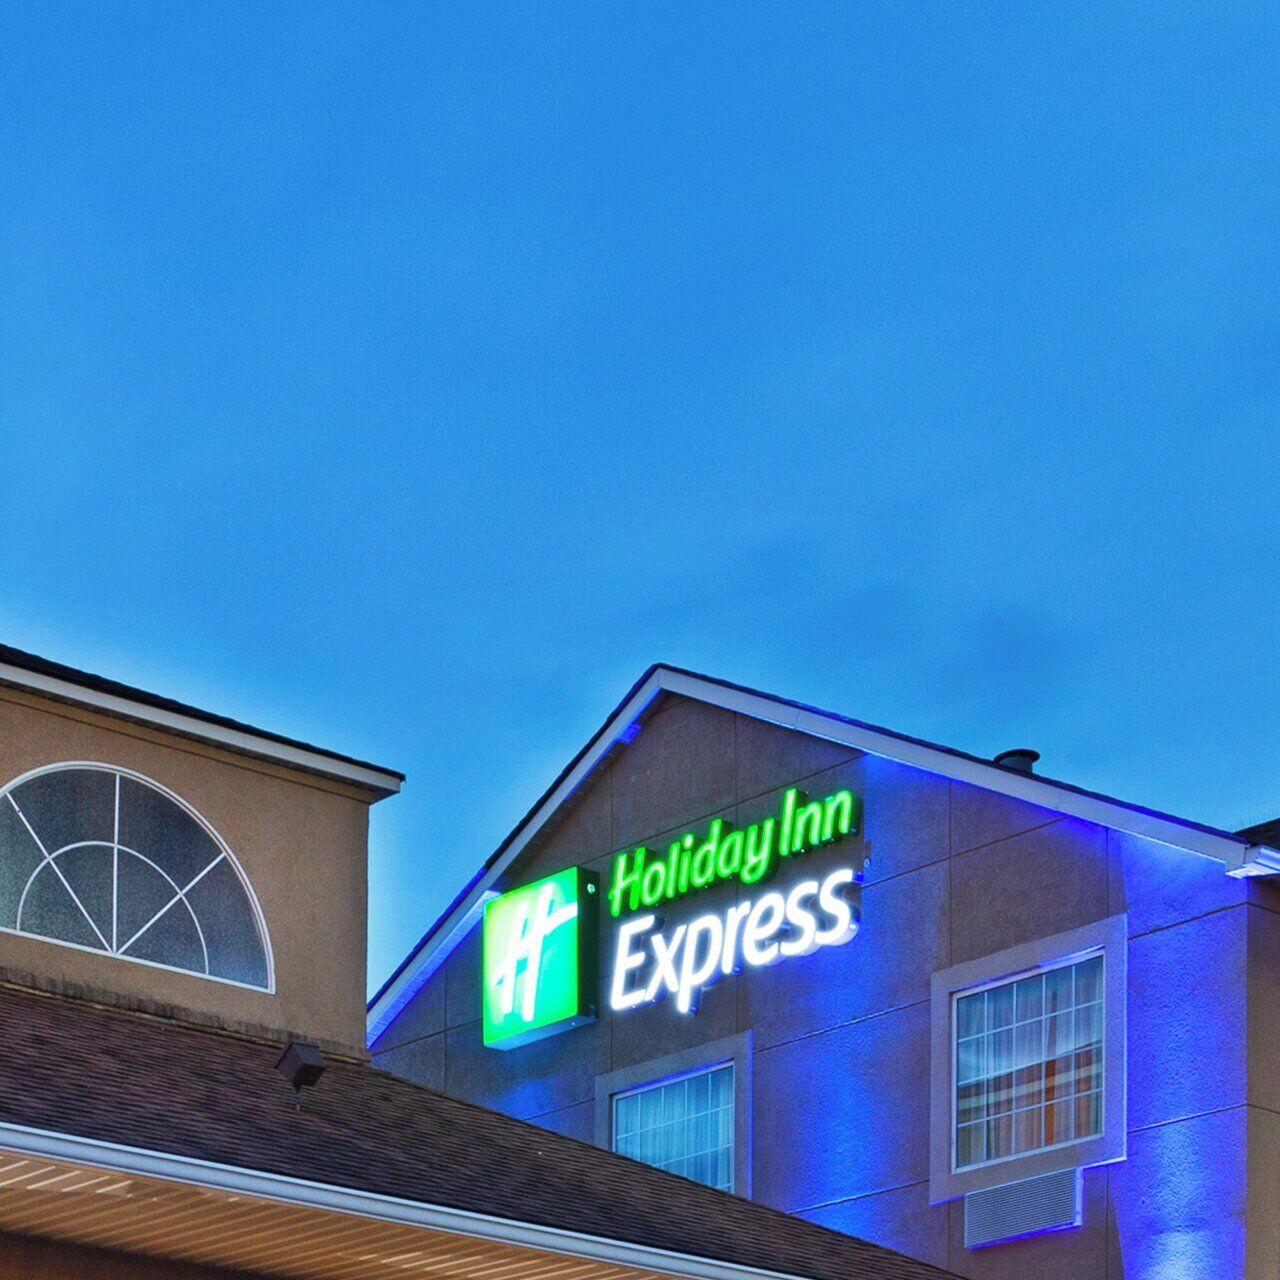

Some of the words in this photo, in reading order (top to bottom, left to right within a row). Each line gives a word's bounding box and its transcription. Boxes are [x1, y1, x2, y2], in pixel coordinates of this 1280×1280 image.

[609, 818, 775, 916] Holiday
[779, 787, 854, 857] Inn
[611, 869, 854, 1014] Express
